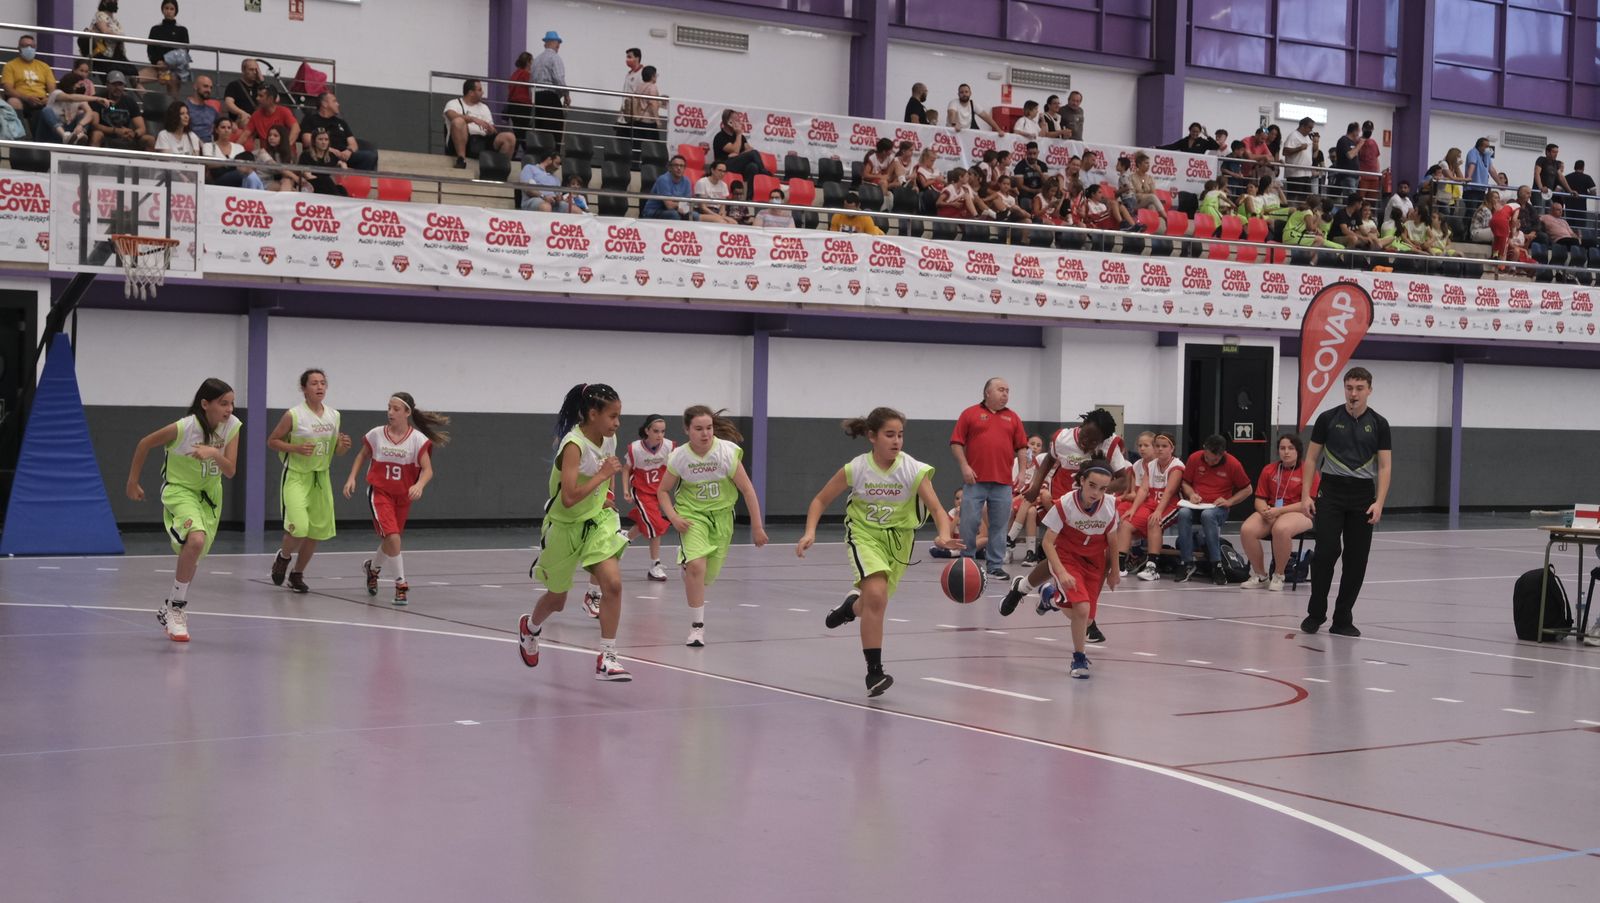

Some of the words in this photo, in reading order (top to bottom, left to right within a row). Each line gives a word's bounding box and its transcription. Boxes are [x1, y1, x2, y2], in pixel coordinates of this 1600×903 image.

[677, 104, 702, 118] COPA
[674, 115, 708, 128] COVAP
[767, 113, 791, 128] COPA
[812, 120, 834, 133] COPA
[763, 125, 797, 138] COVAP
[807, 130, 839, 142] COVAP
[853, 124, 877, 137] COPA
[896, 128, 919, 142] COPA
[850, 134, 879, 147] COVA
[934, 132, 957, 146] COPA
[931, 143, 961, 156] COVAP
[1049, 145, 1069, 156] COPA
[1155, 155, 1174, 167] COPA
[1188, 157, 1208, 169] COPA
[1151, 165, 1177, 176] COVAP
[1186, 168, 1212, 179] COVAP
[0, 179, 45, 197] COPA
[0, 195, 50, 213] COVAP
[226, 197, 267, 214] COPA
[295, 202, 334, 219] COPA
[221, 212, 272, 228] COVAP
[361, 207, 400, 224] COPA
[427, 212, 464, 229] COPA
[291, 217, 341, 233] COVAP
[358, 222, 406, 238] COVAP
[489, 218, 525, 234] COPA
[550, 221, 584, 237] COPA
[423, 227, 470, 243] COVAP
[486, 232, 531, 247] COVAP
[608, 226, 641, 241] COPA
[664, 227, 696, 243] COPA
[720, 231, 751, 246] COPA
[546, 235, 590, 250] COVAP
[605, 239, 646, 253] COVAP
[661, 241, 702, 256] COVAP
[773, 236, 803, 250] COPA
[823, 238, 853, 253] COPA
[872, 241, 899, 256] COPA
[717, 245, 757, 259] COVAP
[769, 249, 809, 262] COVAP
[821, 251, 859, 265] COVAP
[921, 246, 947, 260] COPA
[967, 250, 994, 264] COPA
[868, 254, 905, 268] COVAP
[918, 259, 953, 272] COVAP
[1014, 255, 1040, 268] COPA
[1058, 256, 1083, 270] COPA
[1101, 260, 1126, 273] COPA
[964, 263, 1000, 276] COVAP
[1012, 267, 1044, 279] COVAP
[1056, 269, 1088, 282] COVAP
[1143, 263, 1167, 276] COPA
[1184, 265, 1208, 278] COPA
[1224, 268, 1246, 281] COPA
[1099, 272, 1130, 284] COVAP
[1141, 275, 1171, 287] COVAP
[1182, 277, 1212, 289] COVAP
[1263, 271, 1286, 284] COPA
[1301, 273, 1323, 286] COPA
[1221, 280, 1251, 292] COVAP
[1260, 282, 1290, 294] COVAP
[1373, 279, 1394, 291] COPA
[1409, 281, 1430, 293] COPA
[1445, 285, 1462, 296] COPA
[1371, 290, 1398, 301] COVAP
[1408, 292, 1432, 303] COVAP
[1478, 286, 1496, 298] COPA
[1511, 289, 1529, 299] COPA
[1542, 290, 1560, 302] COPA
[1573, 292, 1589, 303] COPA
[1441, 295, 1466, 305] COVAP
[1475, 296, 1500, 307] COVAP
[1509, 298, 1532, 308] COVAP
[1541, 300, 1563, 311] COVAP
[1572, 302, 1593, 312] COVAP
[1307, 292, 1355, 393] COVAP
[316, 441, 330, 456] 21
[385, 465, 401, 480] 19
[693, 466, 717, 474] COVAP
[646, 470, 659, 484] 12
[696, 482, 719, 499] 20
[869, 488, 900, 496] COVAP
[866, 503, 894, 524] 22
[1083, 535, 1091, 546] 1
